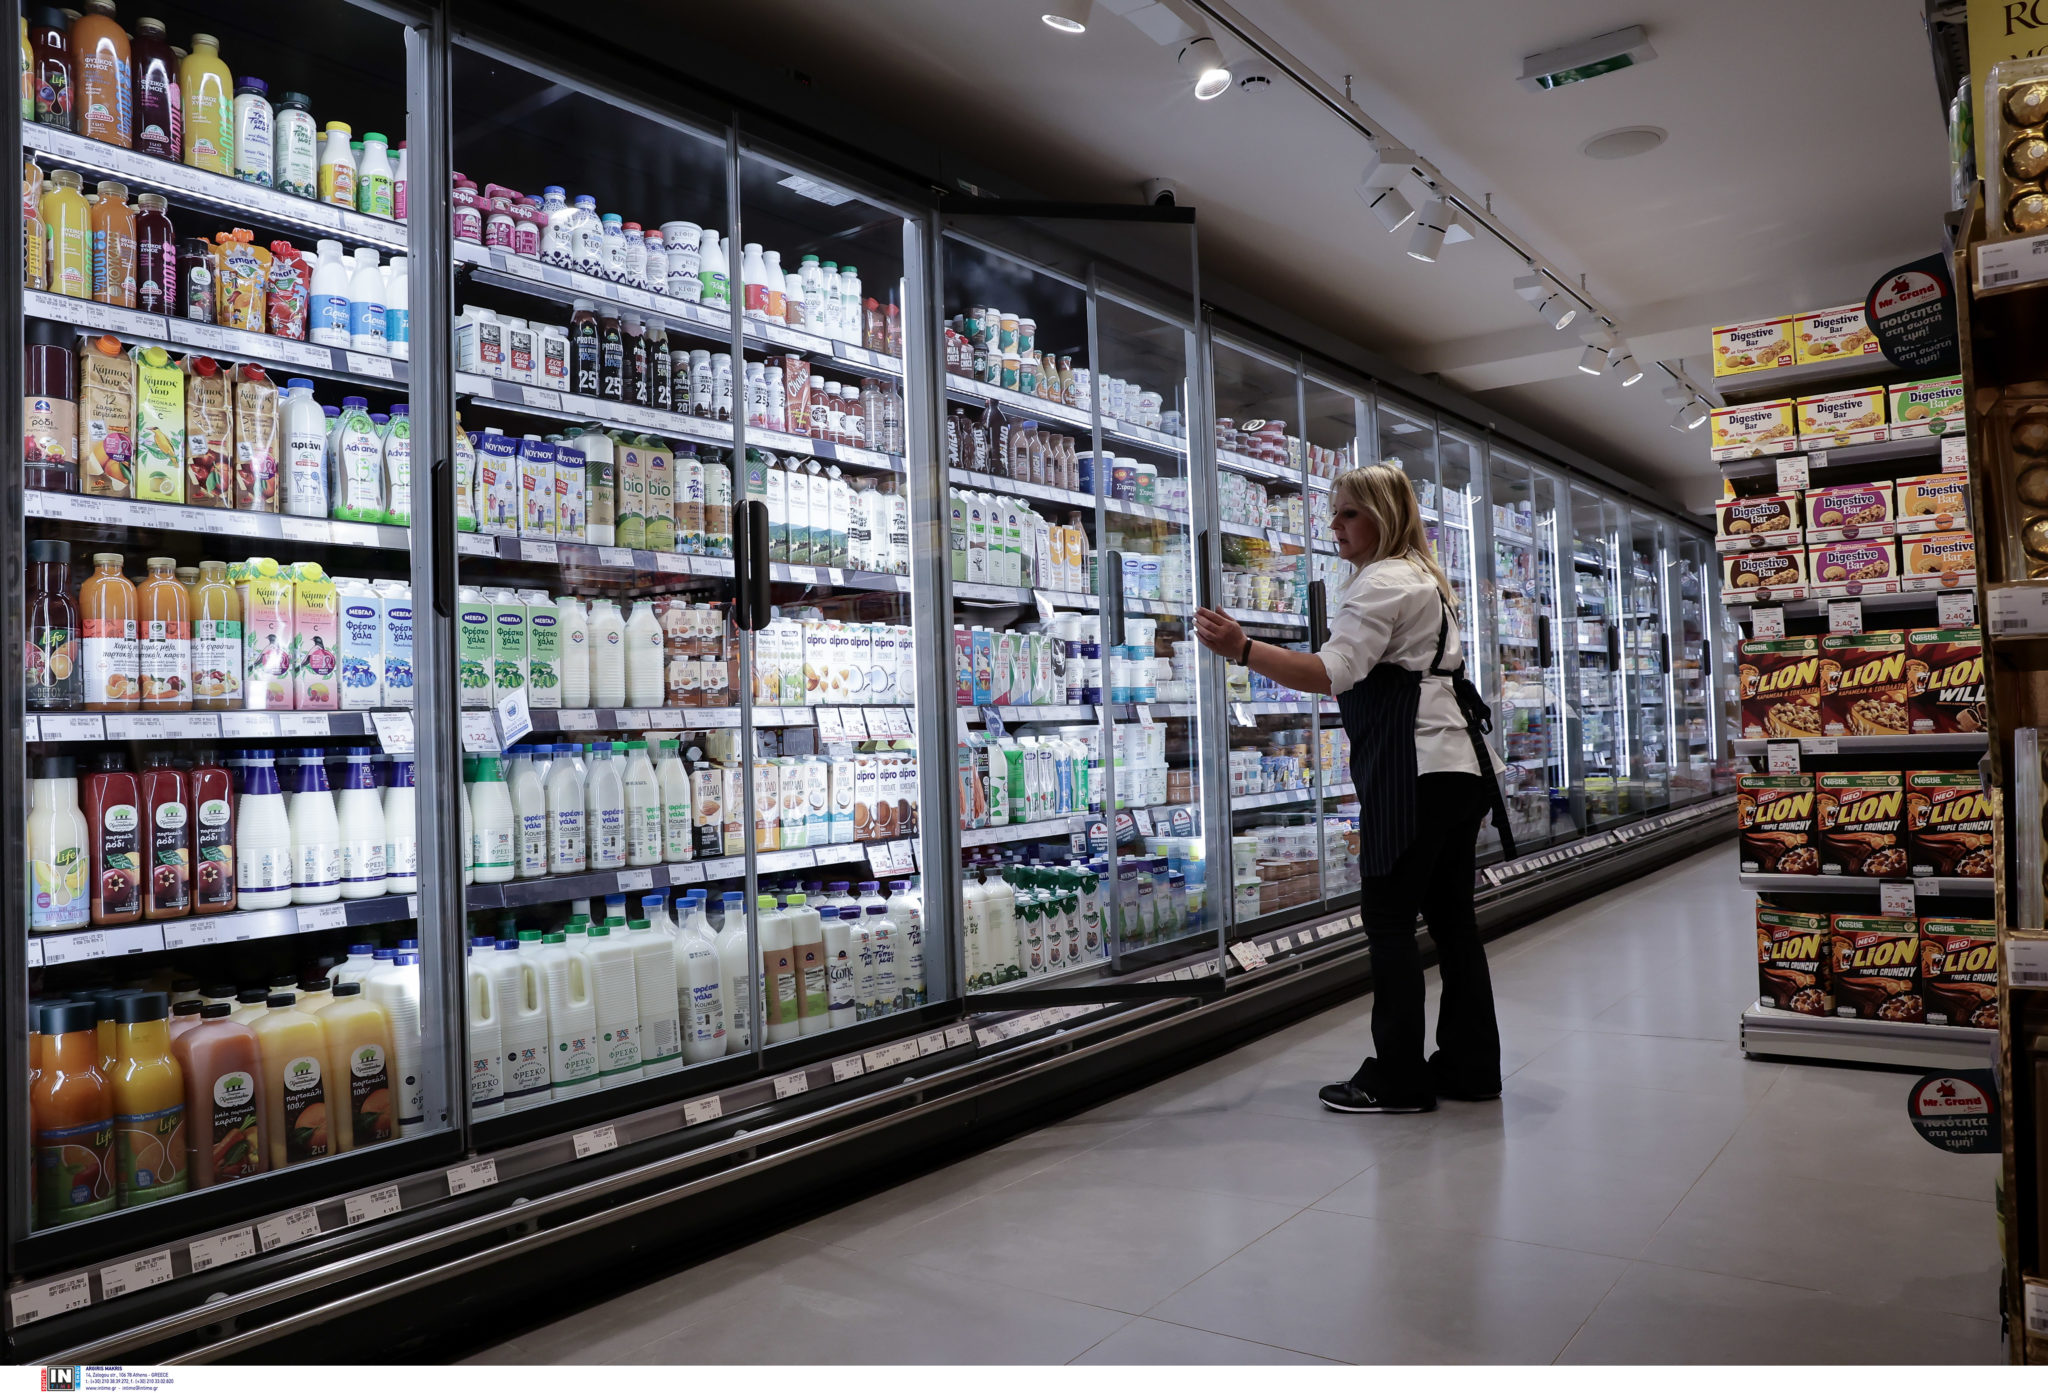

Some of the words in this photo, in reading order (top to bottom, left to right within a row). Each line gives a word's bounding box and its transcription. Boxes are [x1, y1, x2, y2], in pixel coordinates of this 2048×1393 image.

[52, 75, 67, 86] Life
[1878, 299, 1897, 309] Mr.
[1899, 284, 1935, 301] Grand
[1813, 315, 1858, 328] Digestive
[1880, 303, 1942, 329] ποιότητα
[1886, 326, 1904, 337] στη
[1907, 313, 1942, 329] σωστή
[1731, 328, 1773, 341] Digestive
[1902, 327, 1929, 342] τιμή!
[578, 370, 597, 389] 25
[605, 376, 622, 395] 25
[1910, 387, 1962, 402] Digestive
[1817, 399, 1863, 414] Digestive
[1930, 398, 1949, 409] Bar
[1729, 411, 1772, 425] Digestive
[1833, 410, 1847, 418] Bar
[31, 419, 54, 429] ρόδι
[1745, 422, 1757, 430] Bar
[1947, 455, 1966, 463] 2.54
[623, 477, 643, 493] bio
[648, 480, 671, 496] bio
[1824, 494, 1874, 508] Digestive
[1938, 494, 1958, 504] Bar
[1733, 504, 1780, 518] Digestive
[1844, 505, 1861, 514] Bar
[1750, 515, 1768, 524] Bar
[1923, 542, 1975, 555] Digestive
[1827, 550, 1878, 563] Digestive
[1943, 553, 1961, 562] Bar
[1740, 558, 1788, 572] Digestive
[1846, 561, 1864, 570] Bar
[1758, 568, 1776, 577] Bar
[346, 621, 377, 633] Φρέσκο
[461, 626, 489, 639] Φρέσκο
[42, 631, 66, 647] Life
[352, 632, 373, 640] γάλα
[497, 627, 524, 640] Φρέσκο
[532, 628, 558, 640] Φρέσκο
[807, 634, 827, 645] alpro
[468, 635, 486, 645] γάλα
[502, 636, 520, 646] γάλα
[537, 637, 554, 646] γάλα
[829, 635, 849, 647] alpro
[850, 636, 870, 649] alpro
[875, 637, 894, 649] alpro
[1758, 658, 1818, 692] LION
[1840, 653, 1905, 688] LION
[857, 770, 876, 782] alpro
[880, 769, 897, 781] alpro
[899, 767, 916, 779] alpro
[1760, 793, 1775, 802] NEO
[1843, 792, 1860, 802] NEO
[1935, 791, 1953, 801] NEO
[1755, 792, 1814, 823] LION
[1838, 791, 1902, 823] LION
[1929, 793, 1993, 823] LION
[1779, 820, 1812, 830] CRUNCHY
[1864, 820, 1900, 831] CRUNCHY
[56, 849, 77, 865] Life
[1887, 901, 1906, 909] 2.58
[1774, 931, 1788, 940] NEO
[1857, 936, 1877, 946] NEO
[1771, 934, 1821, 960] LION
[1949, 940, 1968, 950] NEO
[1853, 938, 1918, 967] LION
[1776, 961, 1790, 969] TRIPLE
[1790, 961, 1819, 972] CRUNCHY
[1878, 967, 1916, 977] CRUNCHY
[1951, 974, 1971, 982] TRIPLE
[608, 1046, 639, 1059] ΦΡΕΣΚΟ
[564, 1056, 595, 1070] ΦΡΕΣΚΟ
[513, 1067, 545, 1080] ΦΡΕΣΚΟ
[353, 1074, 386, 1087] πορτοκάλι
[286, 1089, 322, 1101] πορτοκάλι
[353, 1087, 370, 1096] 100%
[287, 1101, 306, 1110] 100%
[1923, 1099, 1942, 1107] Mr.
[1944, 1097, 1982, 1106] Grand
[160, 1113, 178, 1132] Life
[1923, 1116, 1988, 1127] ποιότητα
[96, 1129, 113, 1146] Life
[1950, 1127, 1988, 1137] σωστή
[1945, 1137, 1974, 1147] τιμή!
[312, 1146, 326, 1155] 2LT
